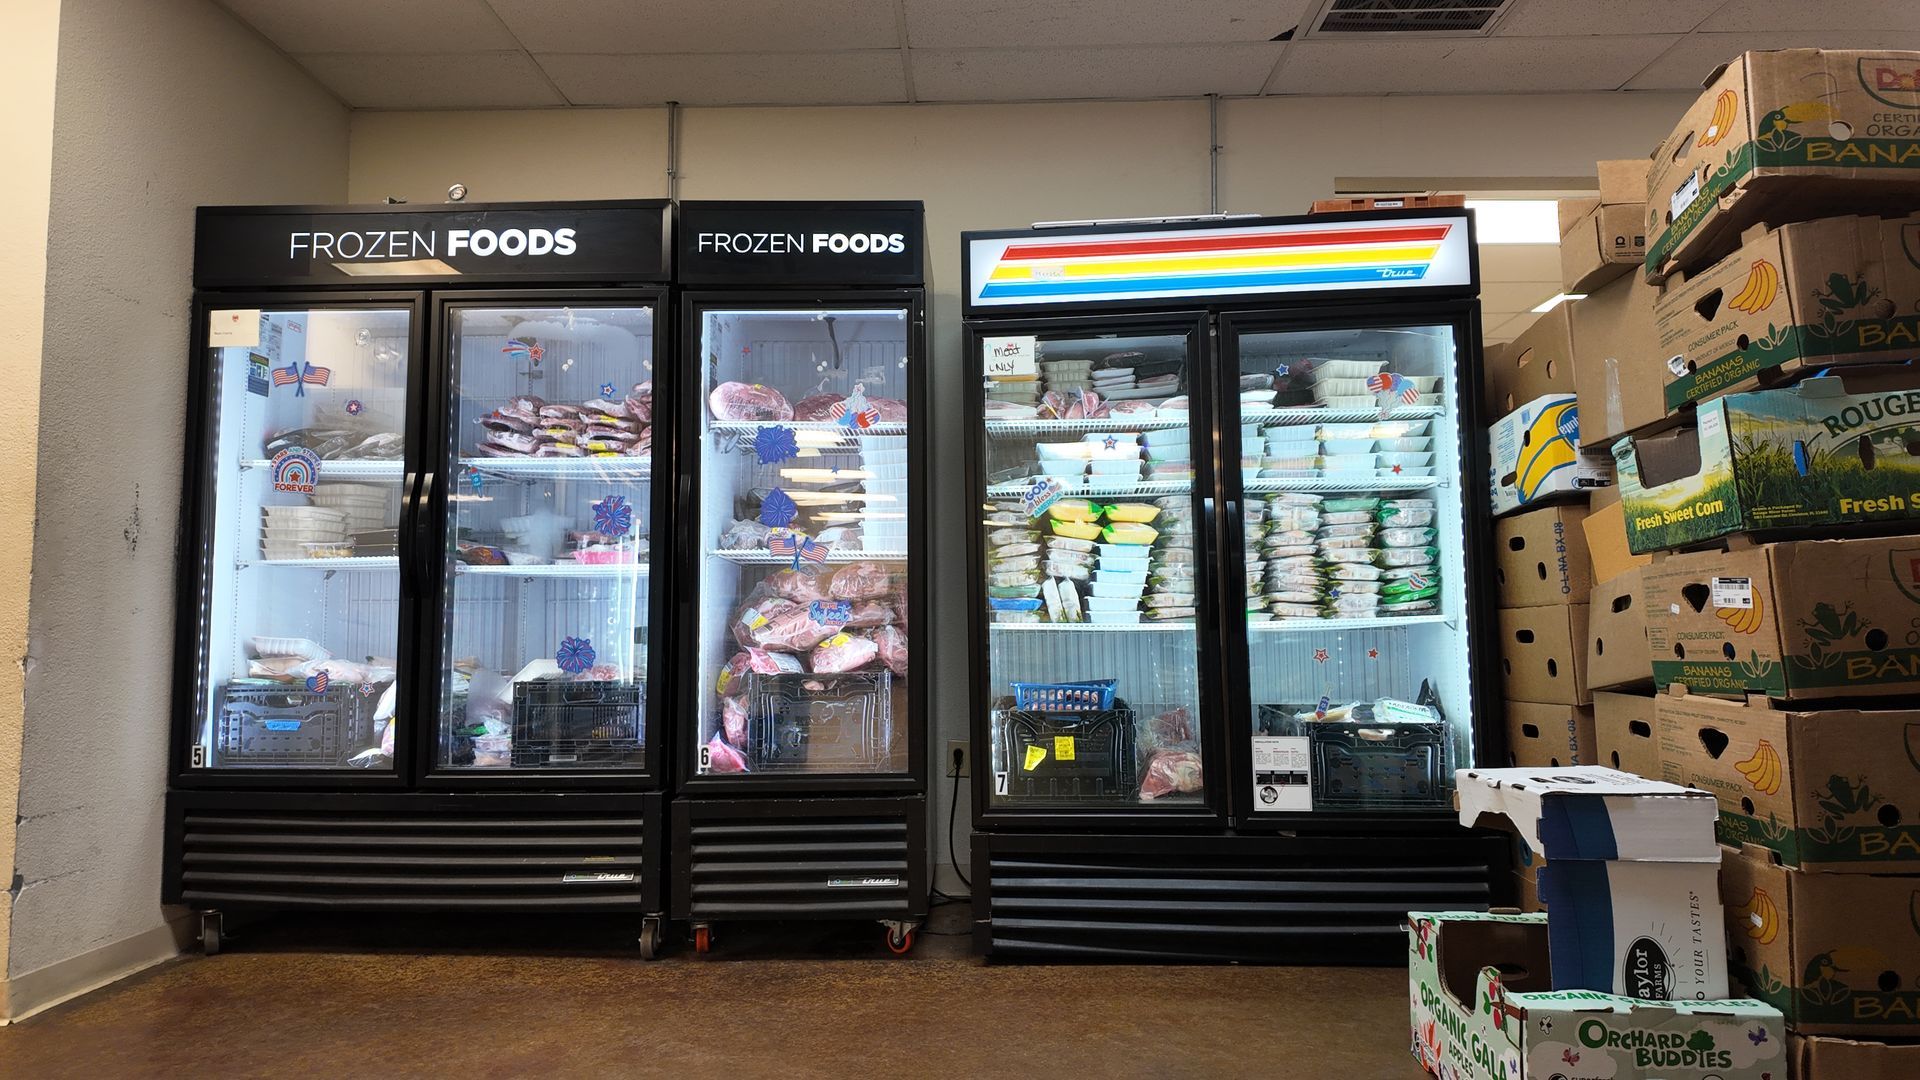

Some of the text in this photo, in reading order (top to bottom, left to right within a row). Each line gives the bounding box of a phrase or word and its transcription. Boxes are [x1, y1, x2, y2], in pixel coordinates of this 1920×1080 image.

[290, 228, 577, 259] FROZEN FOODS
[698, 233, 905, 254] FROZEN FOODS
[1376, 268, 1418, 278] True
[1721, 320, 1739, 335] PACK
[1858, 321, 1920, 346] BA
[1686, 358, 1760, 399] CERTIFIED ORGANIC
[1695, 355, 1744, 384] BANANAS
[1821, 392, 1920, 439] ROUGE
[275, 483, 314, 493] FOREVER
[1025, 481, 1048, 501] GOD
[1840, 495, 1905, 514] Fresh
[1636, 500, 1723, 531] Fresh Sweet Corn
[1683, 665, 1732, 676] BANANAS
[1713, 678, 1749, 689] ORGANIC
[194, 748, 201, 765] 5
[701, 748, 709, 765] 6
[998, 774, 1005, 792] 7
[1726, 782, 1744, 794] PACK
[1694, 950, 1705, 984] YOUR
[1654, 964, 1663, 999] FARMS
[1522, 990, 1611, 1002] ORGANIC
[1682, 999, 1759, 1008] APPLES
[1421, 981, 1467, 1050] ORGANIC
[1471, 1033, 1507, 1080] GALA
[1578, 1019, 1685, 1050] ORCHARD
[1448, 1041, 1475, 1080] APPLES
[1636, 1049, 1733, 1069] BUDDIES
